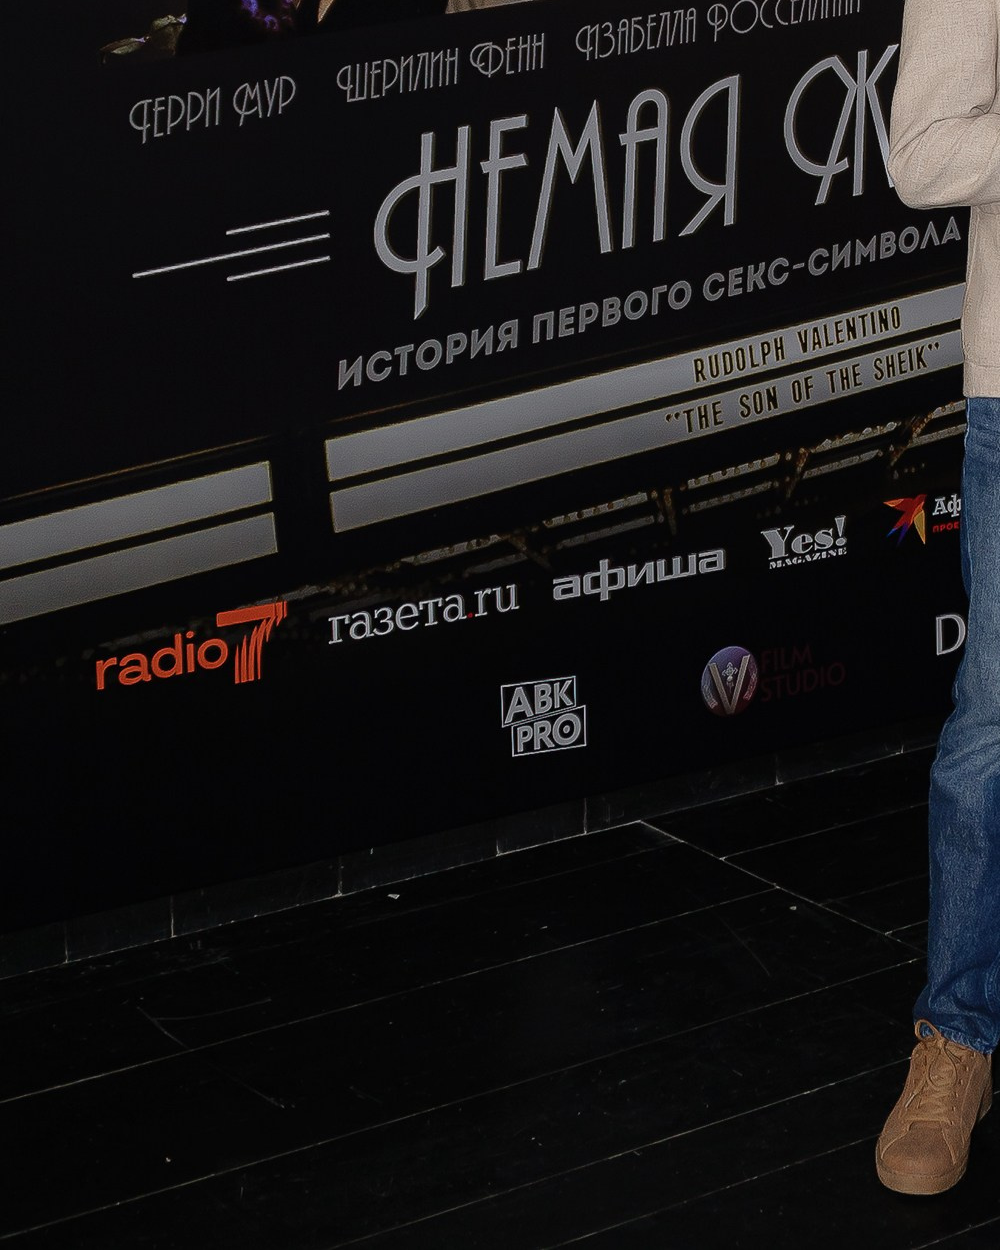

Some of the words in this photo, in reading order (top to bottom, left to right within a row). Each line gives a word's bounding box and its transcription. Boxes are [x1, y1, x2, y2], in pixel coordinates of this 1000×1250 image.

[575, 6, 698, 61] ИЗАБЕЛЛА
[336, 46, 460, 104] ШЕРИЛИН
[469, 31, 546, 80] ФЕНН
[373, 72, 741, 321] НЕМАЯ
[337, 322, 520, 391] ИСТОРИЯ
[531, 283, 693, 346] ПЕРВОГО
[702, 215, 962, 304] СЕКС-СИМВОЛА
[693, 339, 787, 384] RUDOLPH
[797, 305, 902, 353] VALENTINO
[739, 391, 781, 420] SON
[791, 378, 818, 405] OF
[828, 364, 866, 395] THE
[760, 514, 848, 561] Yes!
[768, 546, 848, 570] MAGAZINE
[552, 548, 727, 602] афиша
[327, 581, 520, 646] газета.ru
[760, 645, 813, 676] FILM
[760, 661, 847, 703] STUDIO
[516, 718, 582, 754] PRO
